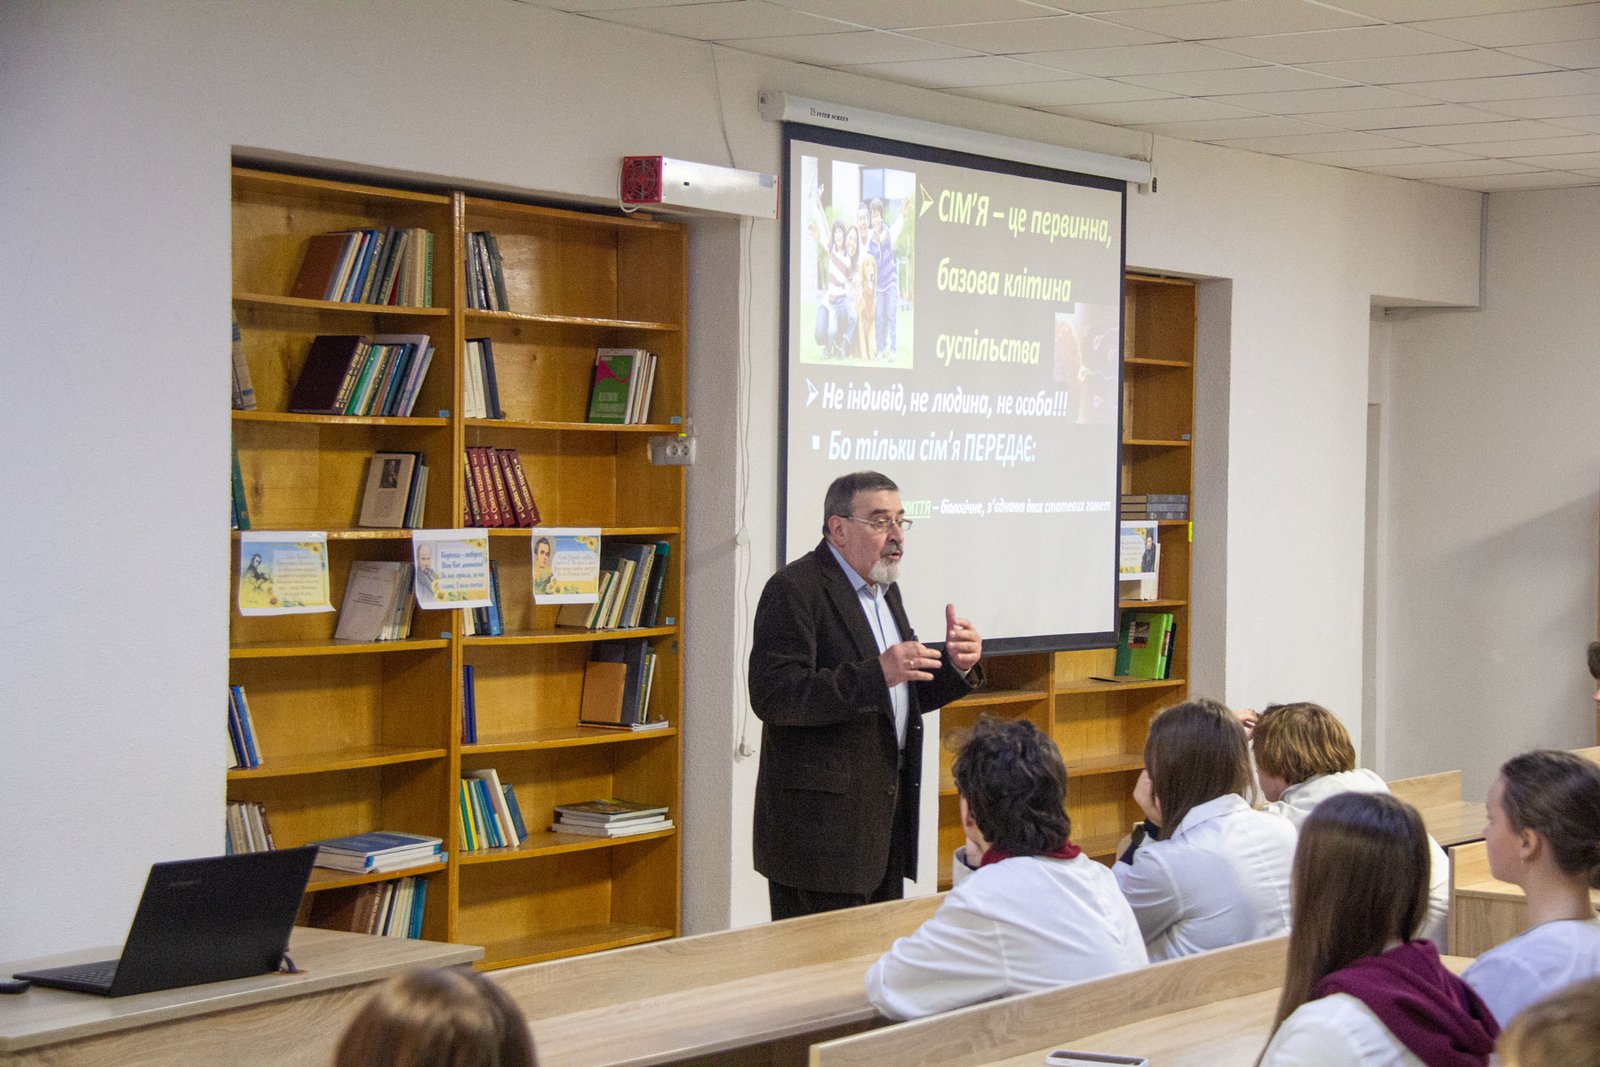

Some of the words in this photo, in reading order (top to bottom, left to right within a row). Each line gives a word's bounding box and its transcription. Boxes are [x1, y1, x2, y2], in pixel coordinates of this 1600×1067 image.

[816, 111, 831, 119] INTER
[831, 114, 849, 122] SCREEN
[938, 189, 990, 227] СІМ'Я
[1008, 206, 1027, 238] це
[1030, 209, 1112, 249] первинна,
[936, 256, 1000, 296] базова
[1003, 267, 1072, 302] клітина
[935, 328, 1041, 367] суспільства
[822, 381, 844, 410] Не
[846, 381, 907, 416] індивід,
[909, 391, 930, 413] не
[931, 385, 992, 419] людина,
[996, 394, 1013, 415] не
[1015, 390, 1069, 417] особа!!!
[828, 429, 852, 461] Бо
[855, 430, 916, 461] тільки
[919, 430, 961, 461] сім'я
[963, 432, 1037, 467] ПЕРЕДАЄ:
